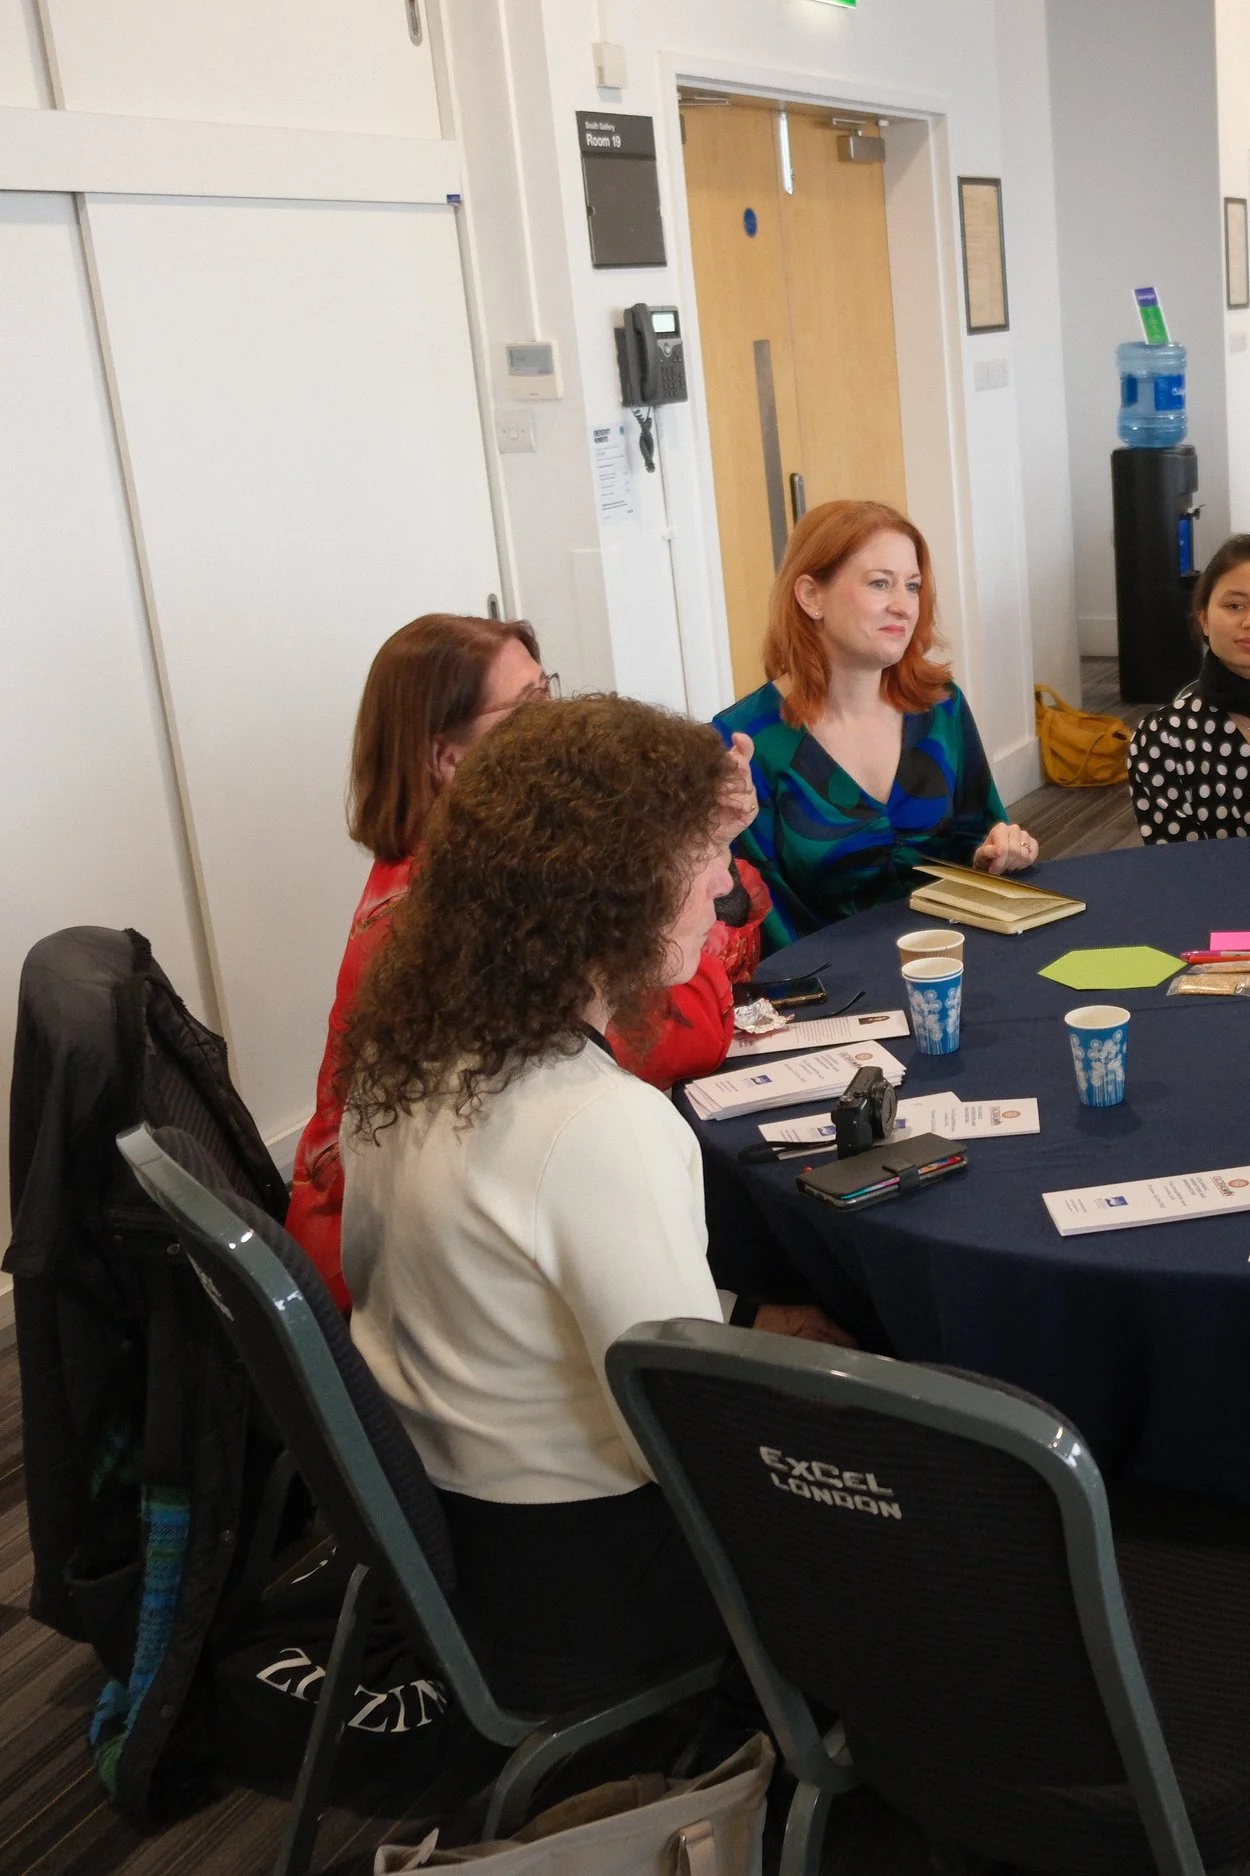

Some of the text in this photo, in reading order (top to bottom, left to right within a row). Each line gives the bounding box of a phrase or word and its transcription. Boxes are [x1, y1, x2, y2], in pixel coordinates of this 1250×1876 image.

[586, 133, 622, 148] Room 19
[770, 1472, 902, 1520] LONDON
